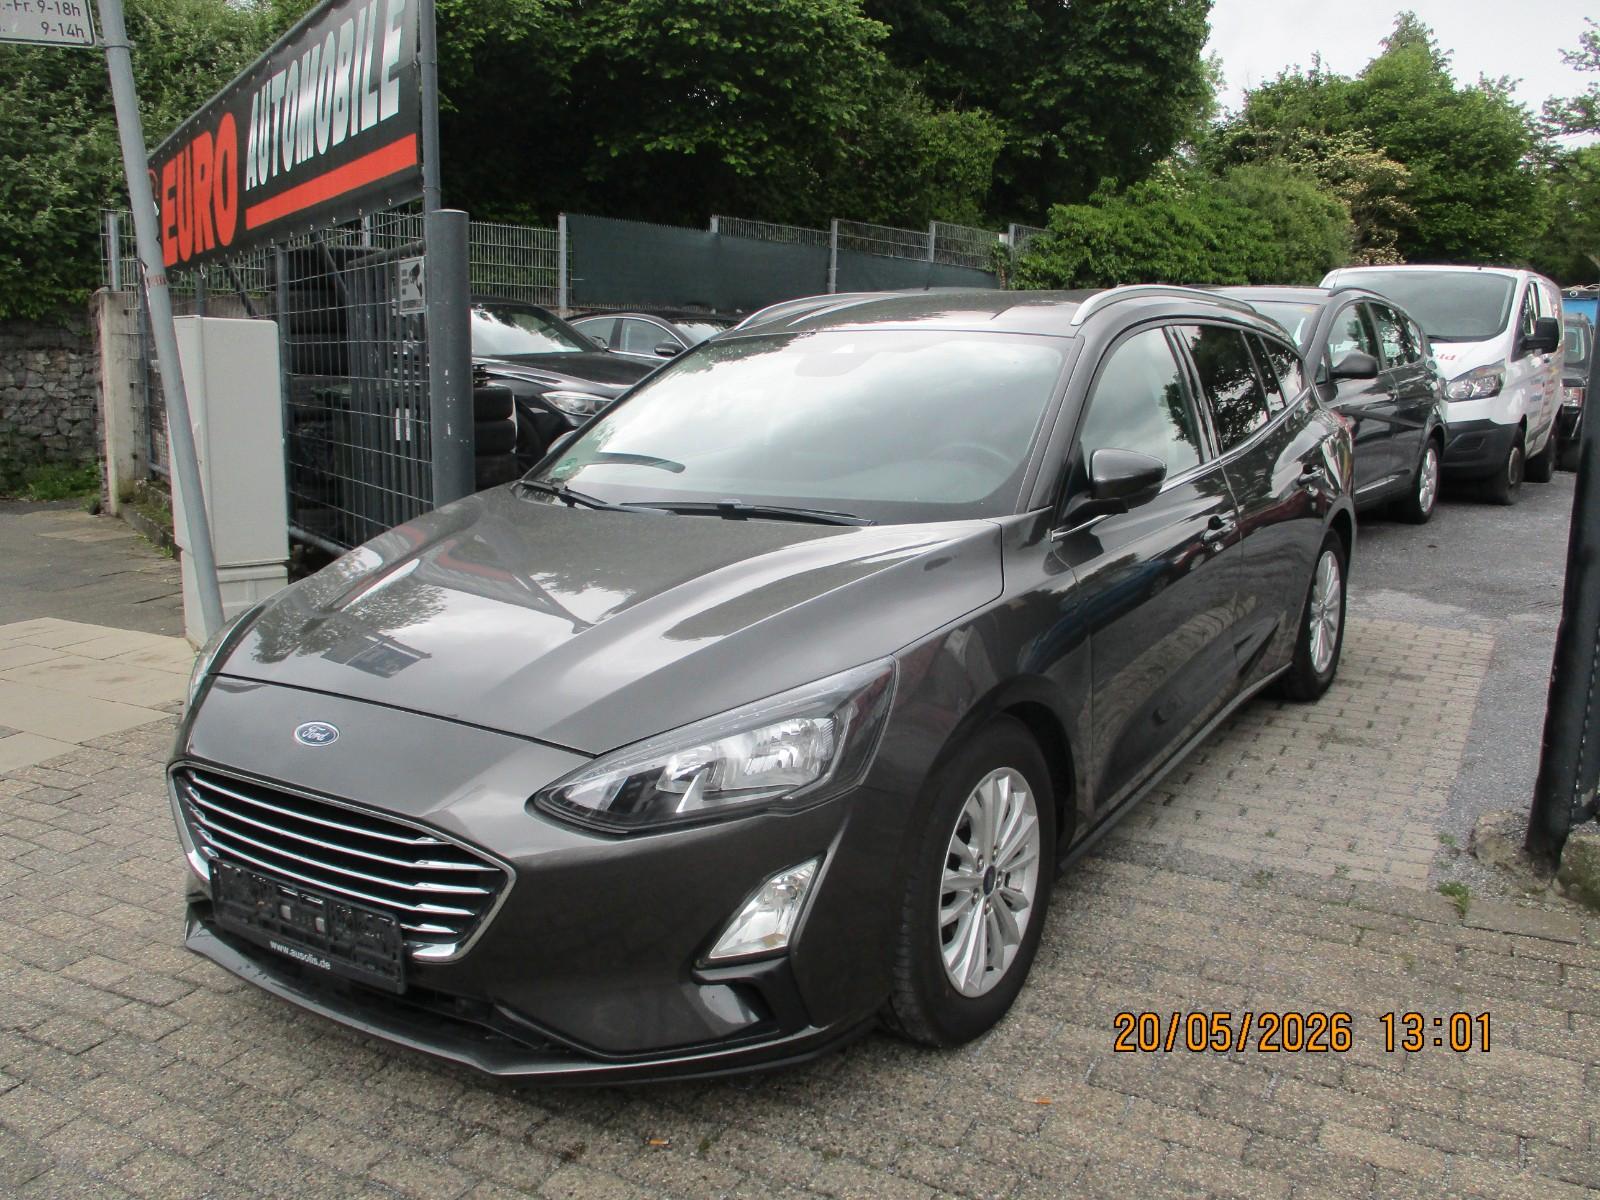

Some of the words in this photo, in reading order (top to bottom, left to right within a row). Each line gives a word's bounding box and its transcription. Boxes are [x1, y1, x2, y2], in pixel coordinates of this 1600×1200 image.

[41, 21, 85, 38] 9-14h
[161, 112, 238, 267] EURO
[246, 0, 404, 191] AUTOMOBILE
